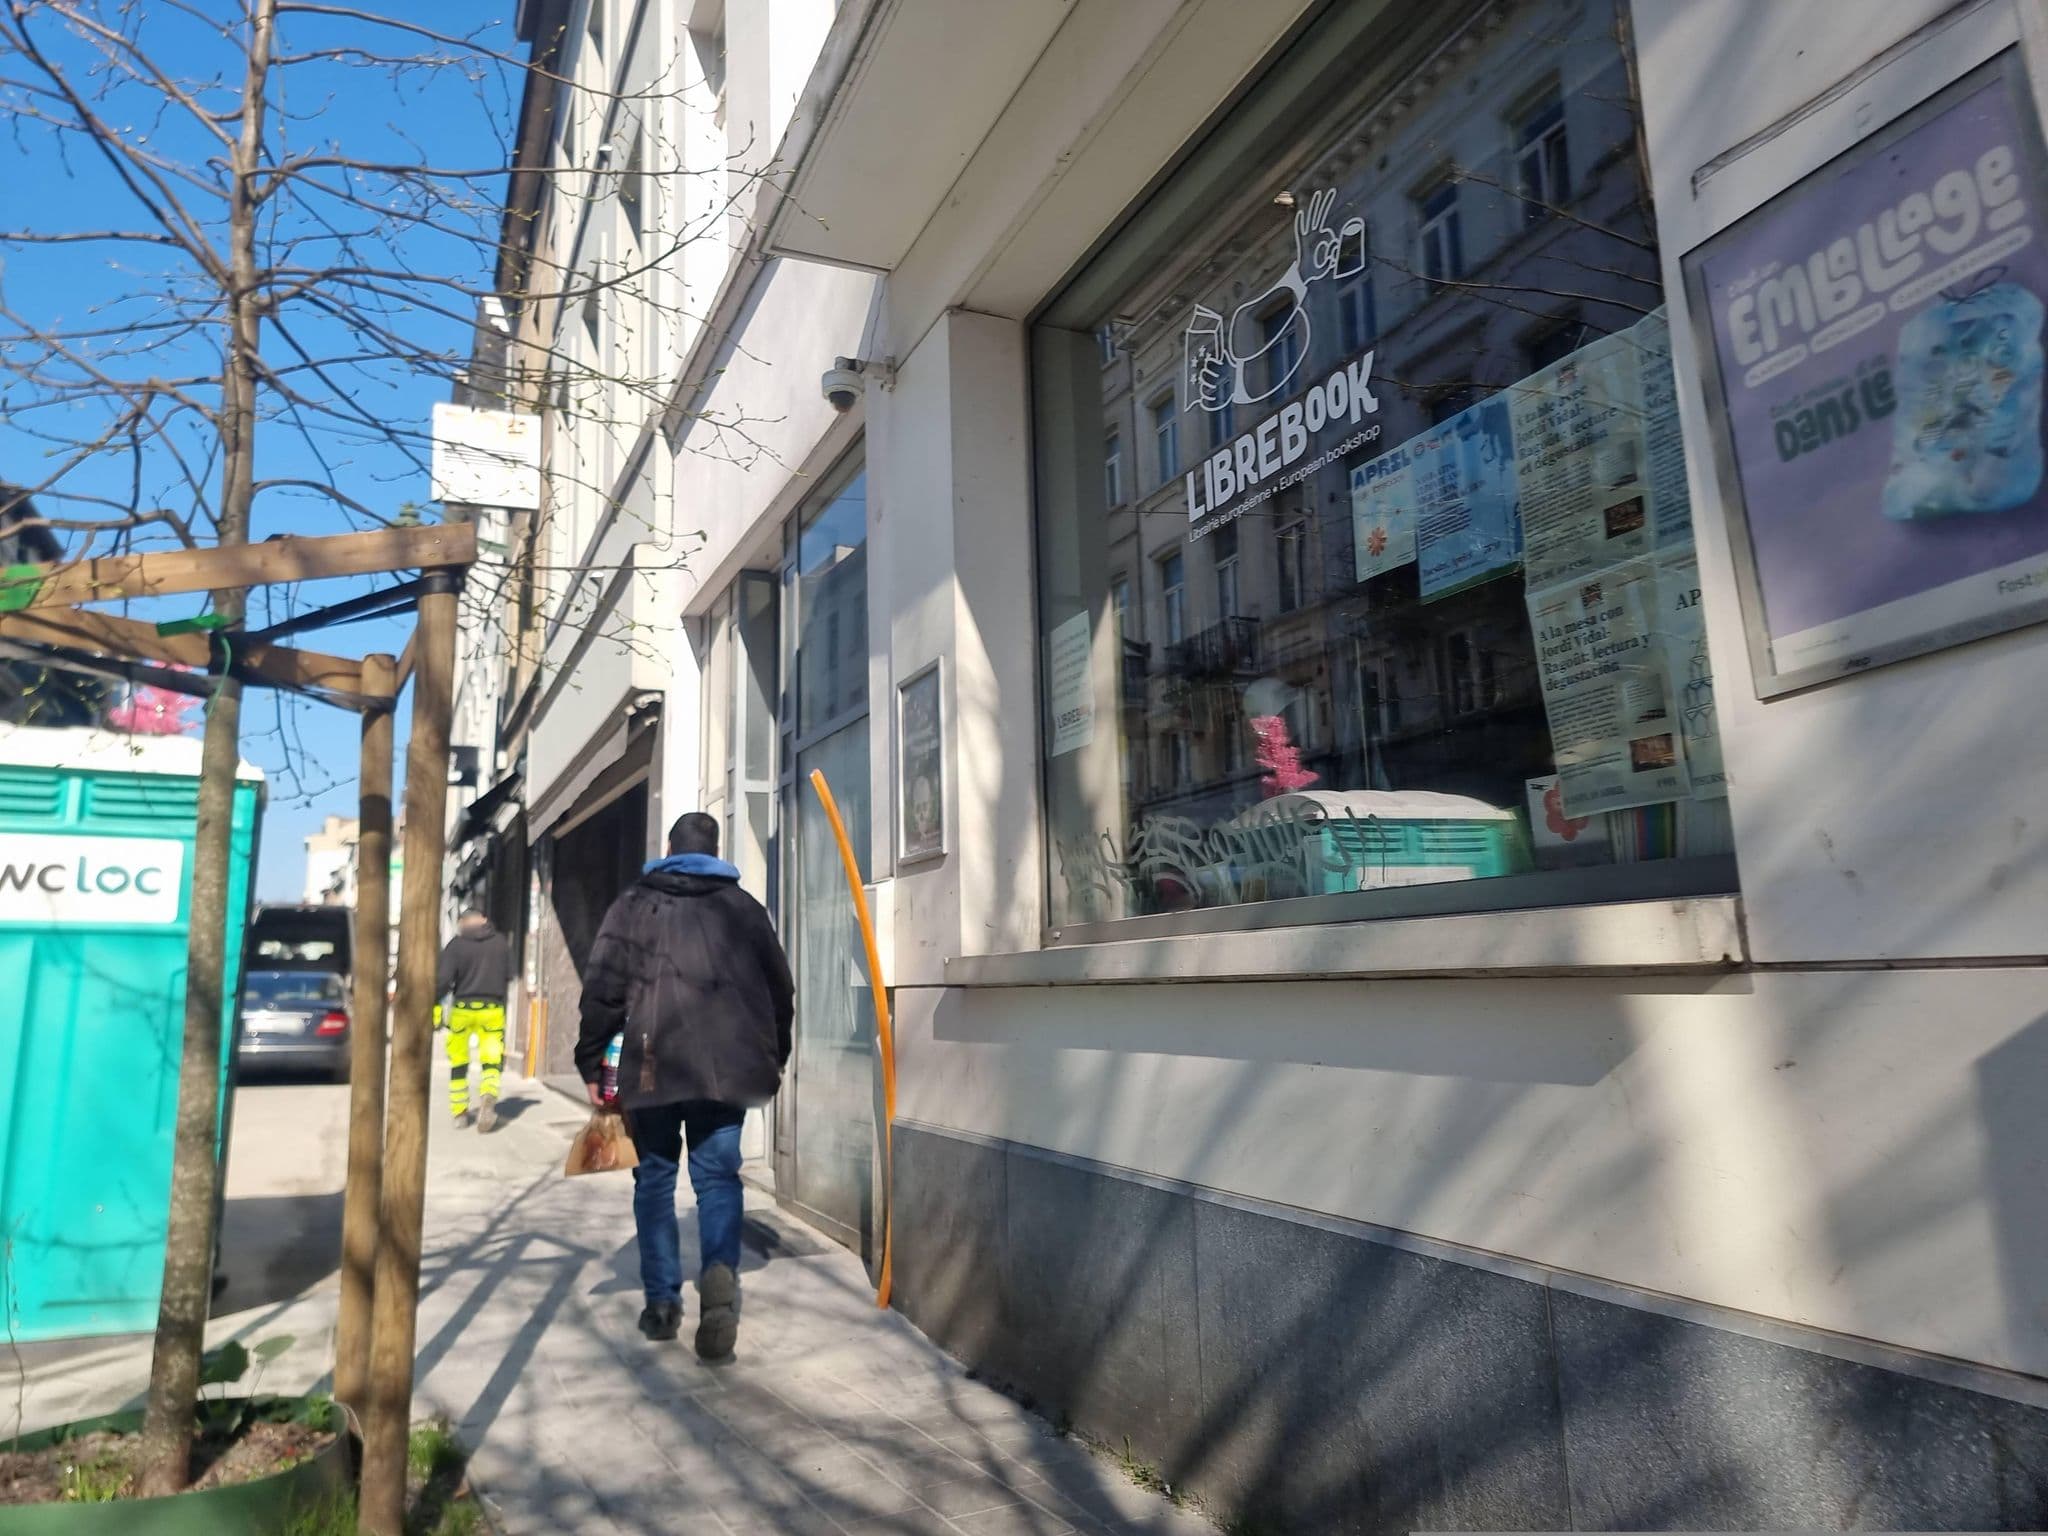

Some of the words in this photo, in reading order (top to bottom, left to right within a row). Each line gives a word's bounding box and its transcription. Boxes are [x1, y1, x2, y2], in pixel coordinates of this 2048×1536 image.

[1189, 520, 1220, 543] Librairie
[1220, 488, 1273, 526] européenne
[1279, 457, 1325, 491] European
[1326, 424, 1381, 464] bookshop
[1354, 449, 1412, 490] APRIL
[1549, 624, 1563, 639] la
[1564, 614, 1597, 634] mesa
[1600, 605, 1625, 622] con
[1541, 638, 1573, 662] Jordi
[1592, 636, 1637, 660] lectura
